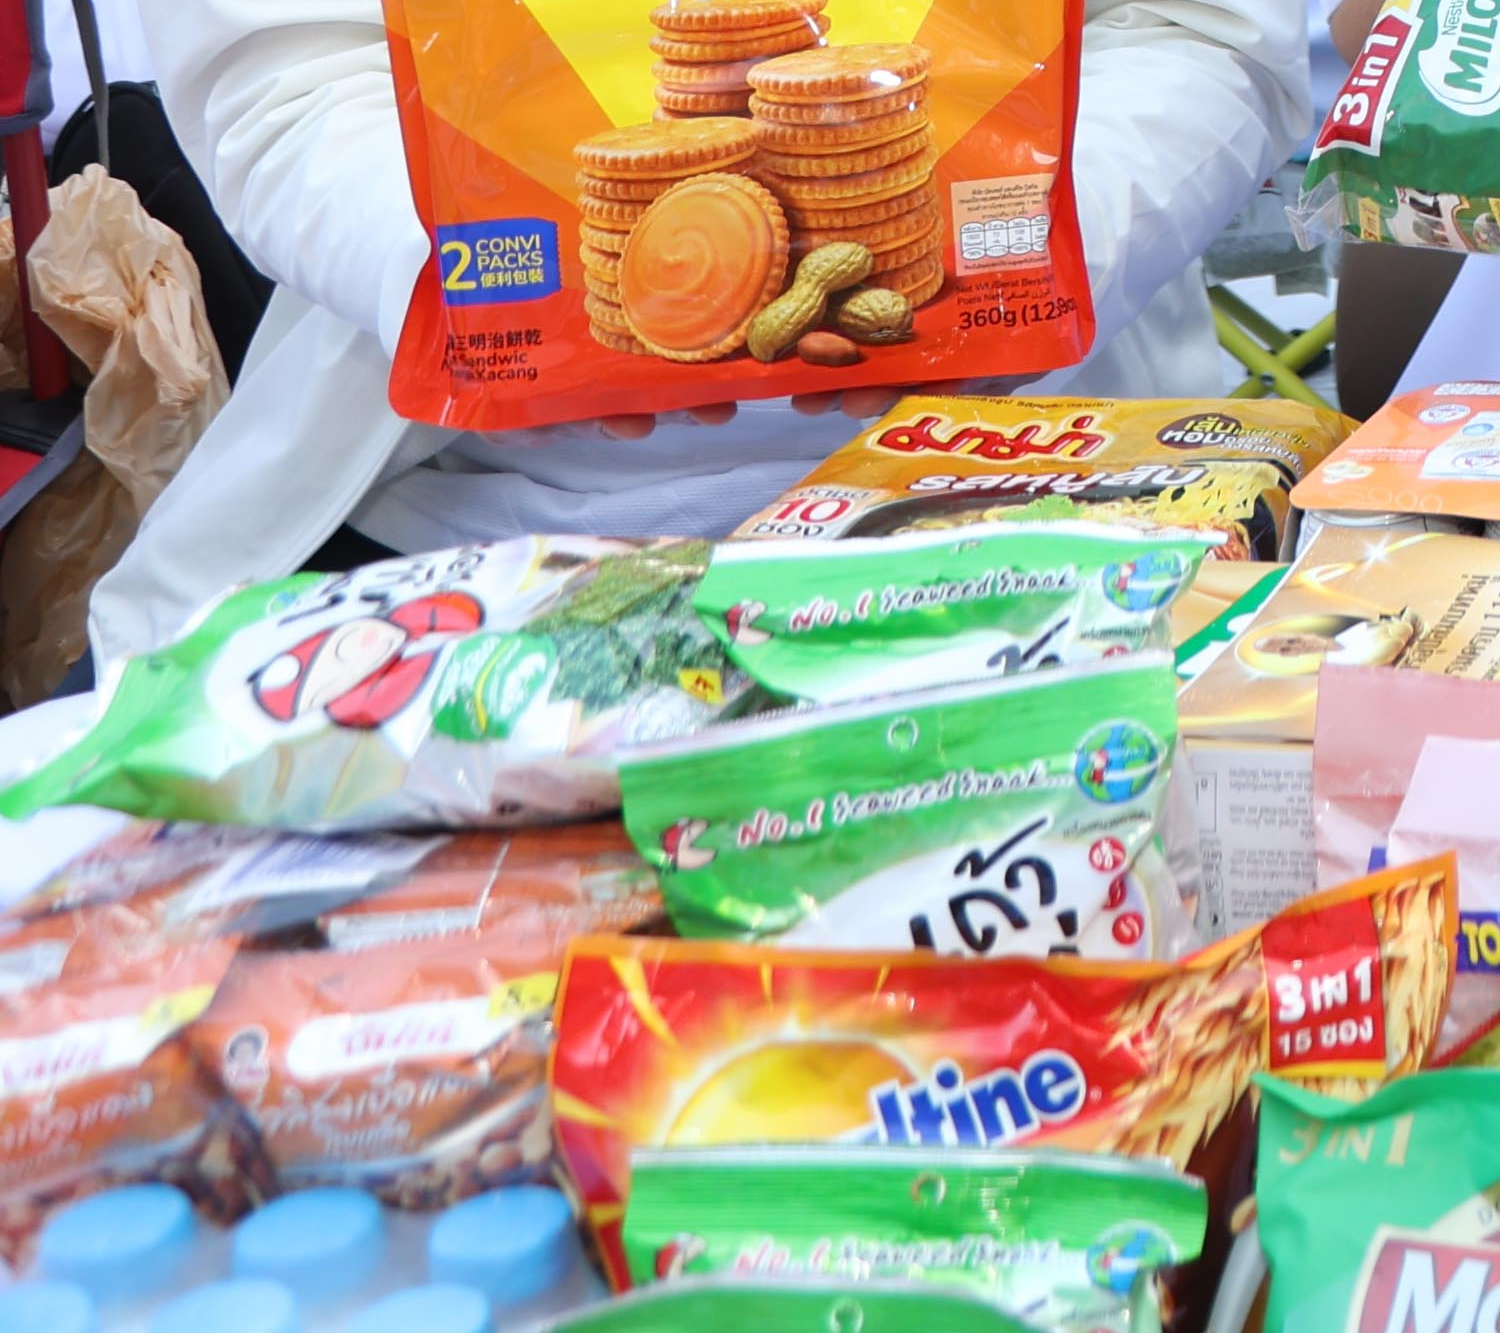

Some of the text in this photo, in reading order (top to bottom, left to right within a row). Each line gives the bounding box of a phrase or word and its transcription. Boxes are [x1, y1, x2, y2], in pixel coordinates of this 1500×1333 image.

[1333, 34, 1398, 126] 3 in 1
[475, 234, 540, 255] CONVI
[476, 251, 544, 271] PACKS
[441, 241, 477, 290] 2
[959, 308, 1016, 330] 360g
[909, 464, 1206, 494] รสหมูสับ
[774, 497, 852, 522] 10
[880, 580, 989, 614] Seaweed
[833, 774, 955, 822] Seaweed
[1274, 956, 1375, 1022] 3 IN 1
[1278, 1016, 1375, 1057] 15 ซอง
[870, 1049, 1086, 1145] ltine
[1321, 1120, 1370, 1165] IN
[1383, 1113, 1417, 1166] 1
